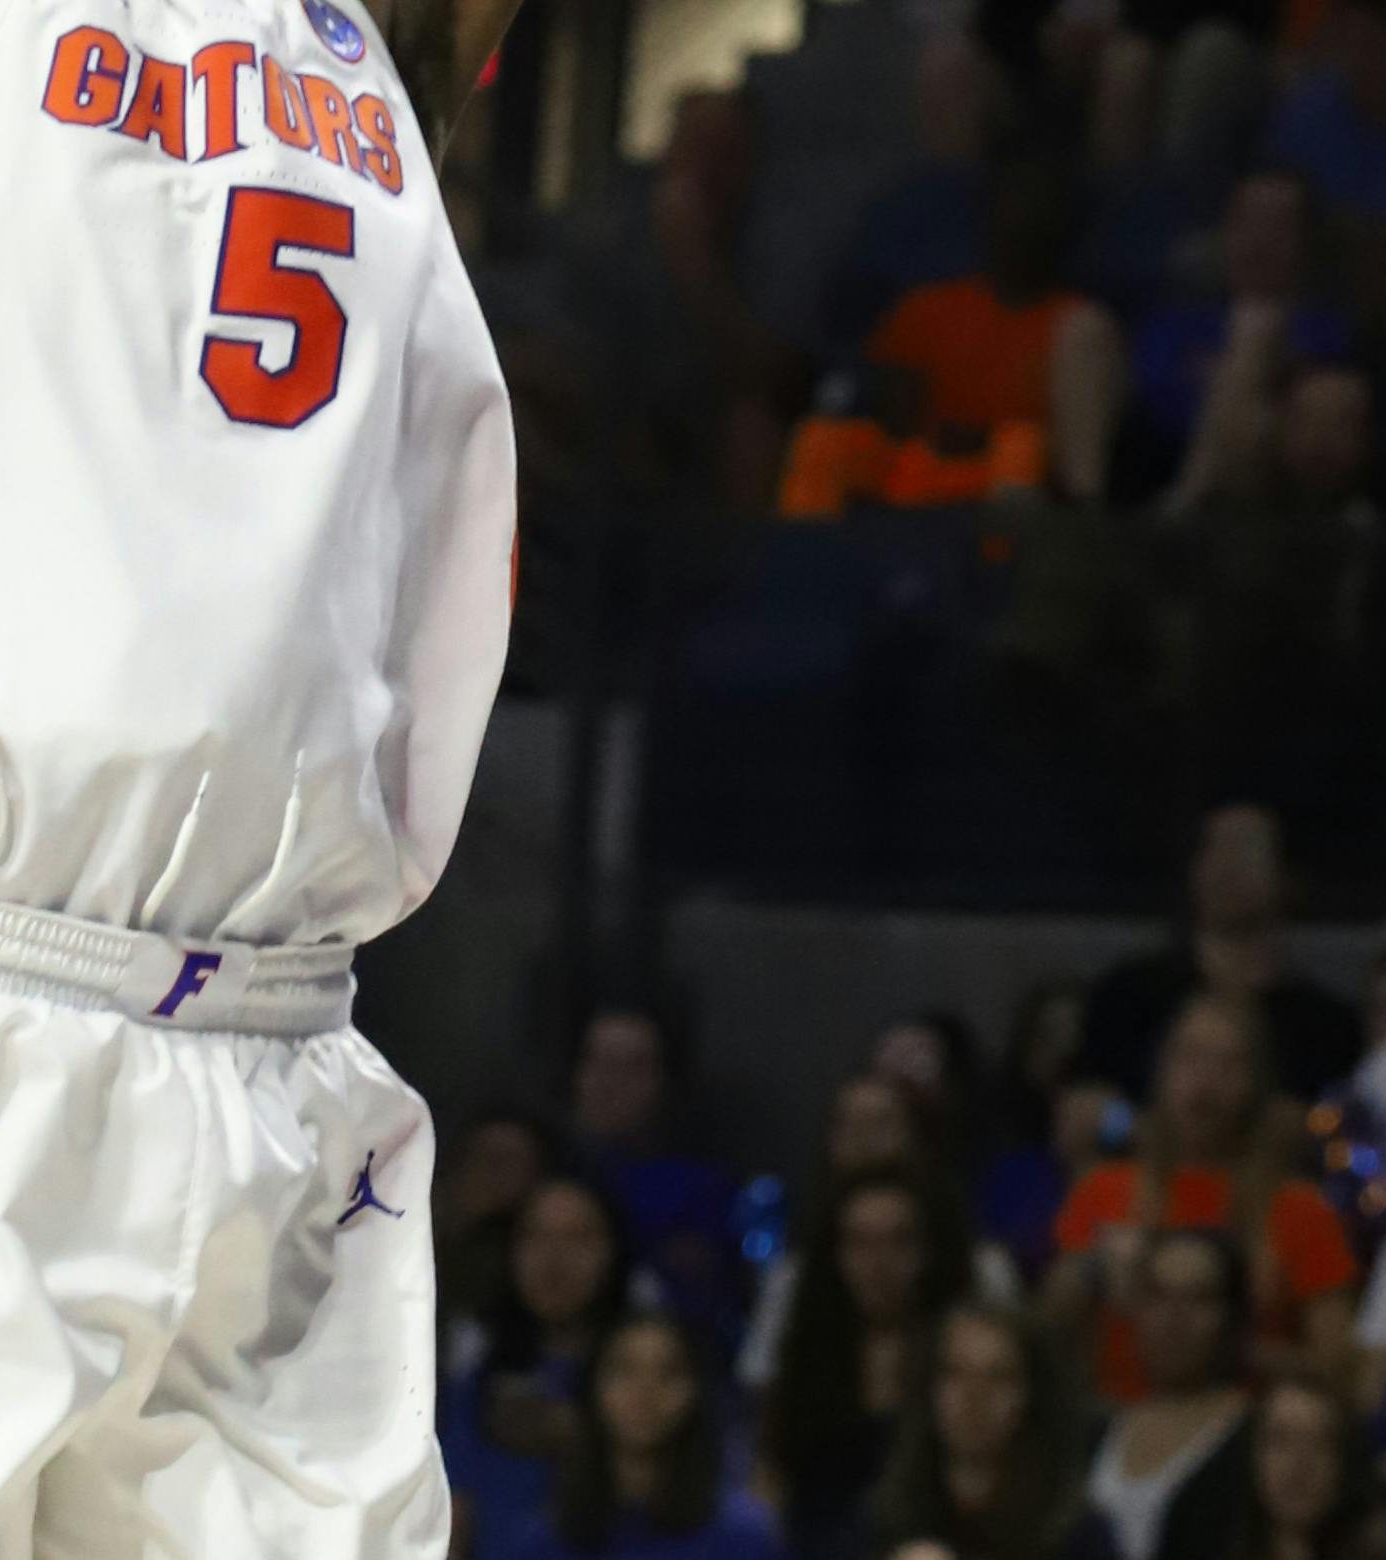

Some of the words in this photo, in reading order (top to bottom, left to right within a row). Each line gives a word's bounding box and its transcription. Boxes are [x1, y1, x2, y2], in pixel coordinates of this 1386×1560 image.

[41, 25, 403, 195] GATORS
[200, 185, 355, 429] 5
[151, 951, 222, 1017] F
